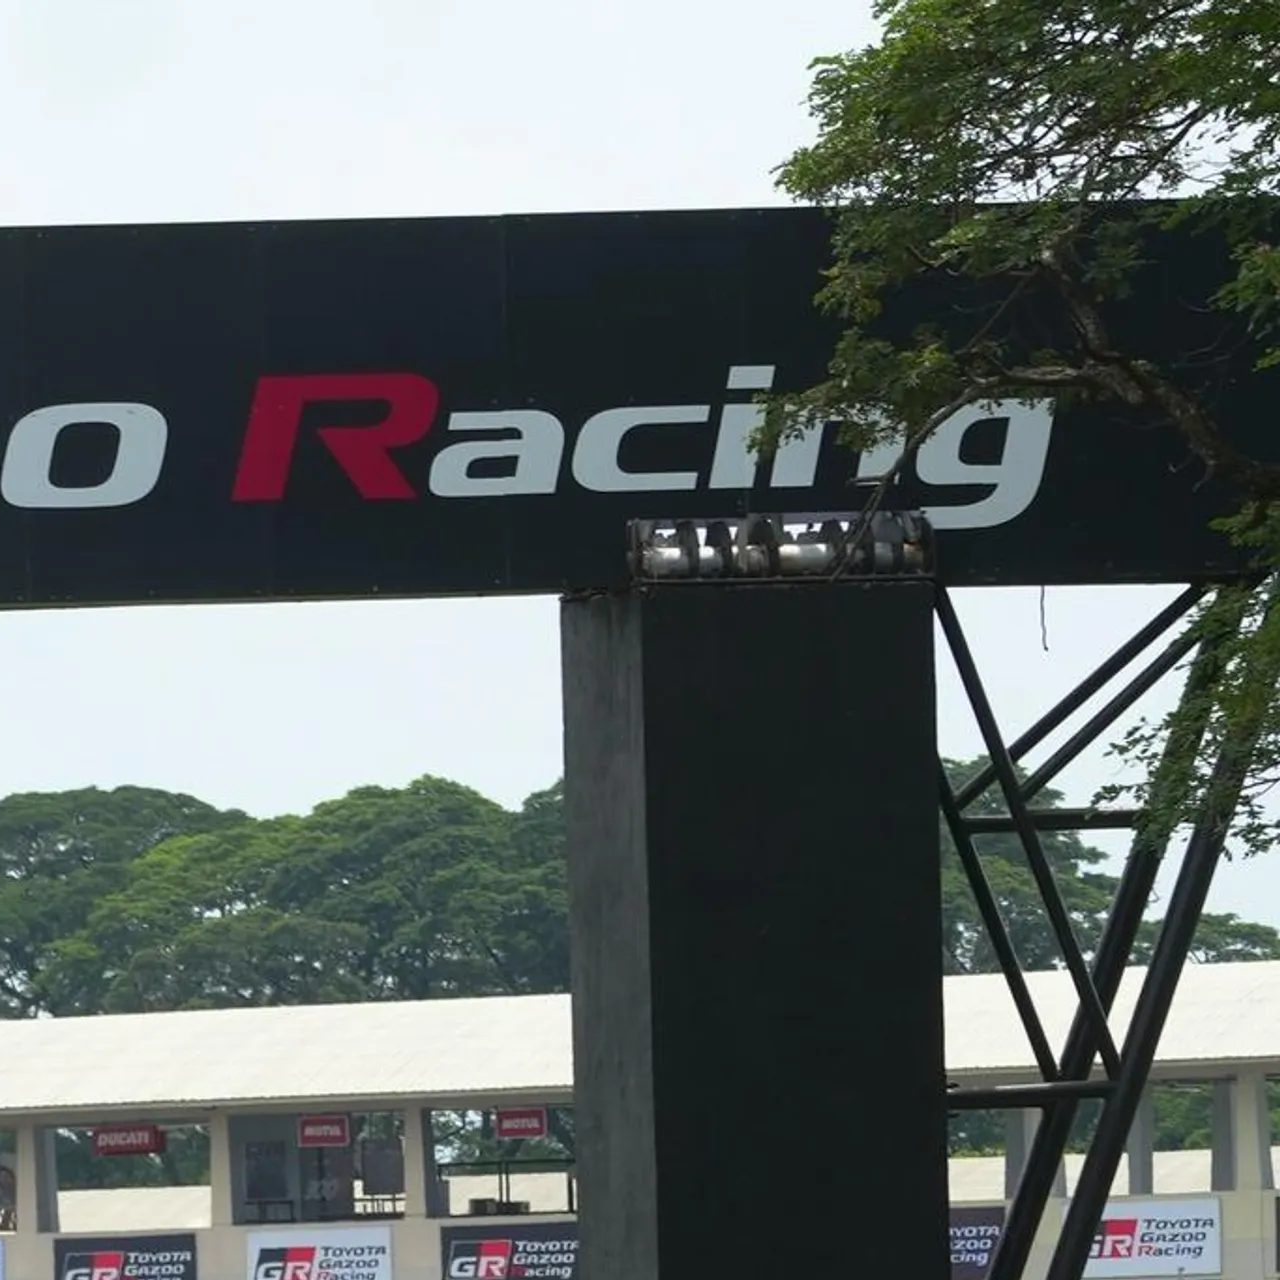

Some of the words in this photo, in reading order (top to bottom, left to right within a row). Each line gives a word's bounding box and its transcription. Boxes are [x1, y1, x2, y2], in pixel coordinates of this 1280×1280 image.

[231, 367, 1053, 530] Racing
[97, 1130, 150, 1146] DUCATI
[1143, 1219, 1214, 1229] TOYOTA
[1140, 1232, 1206, 1242] GAZOO
[322, 1246, 386, 1256] TOYOTA
[127, 1252, 190, 1262] TOYOTA
[514, 1254, 575, 1263] GAZOO
[319, 1259, 379, 1269] GAZOO
[450, 1257, 508, 1278] GR
[125, 1265, 184, 1275] GAZOO
